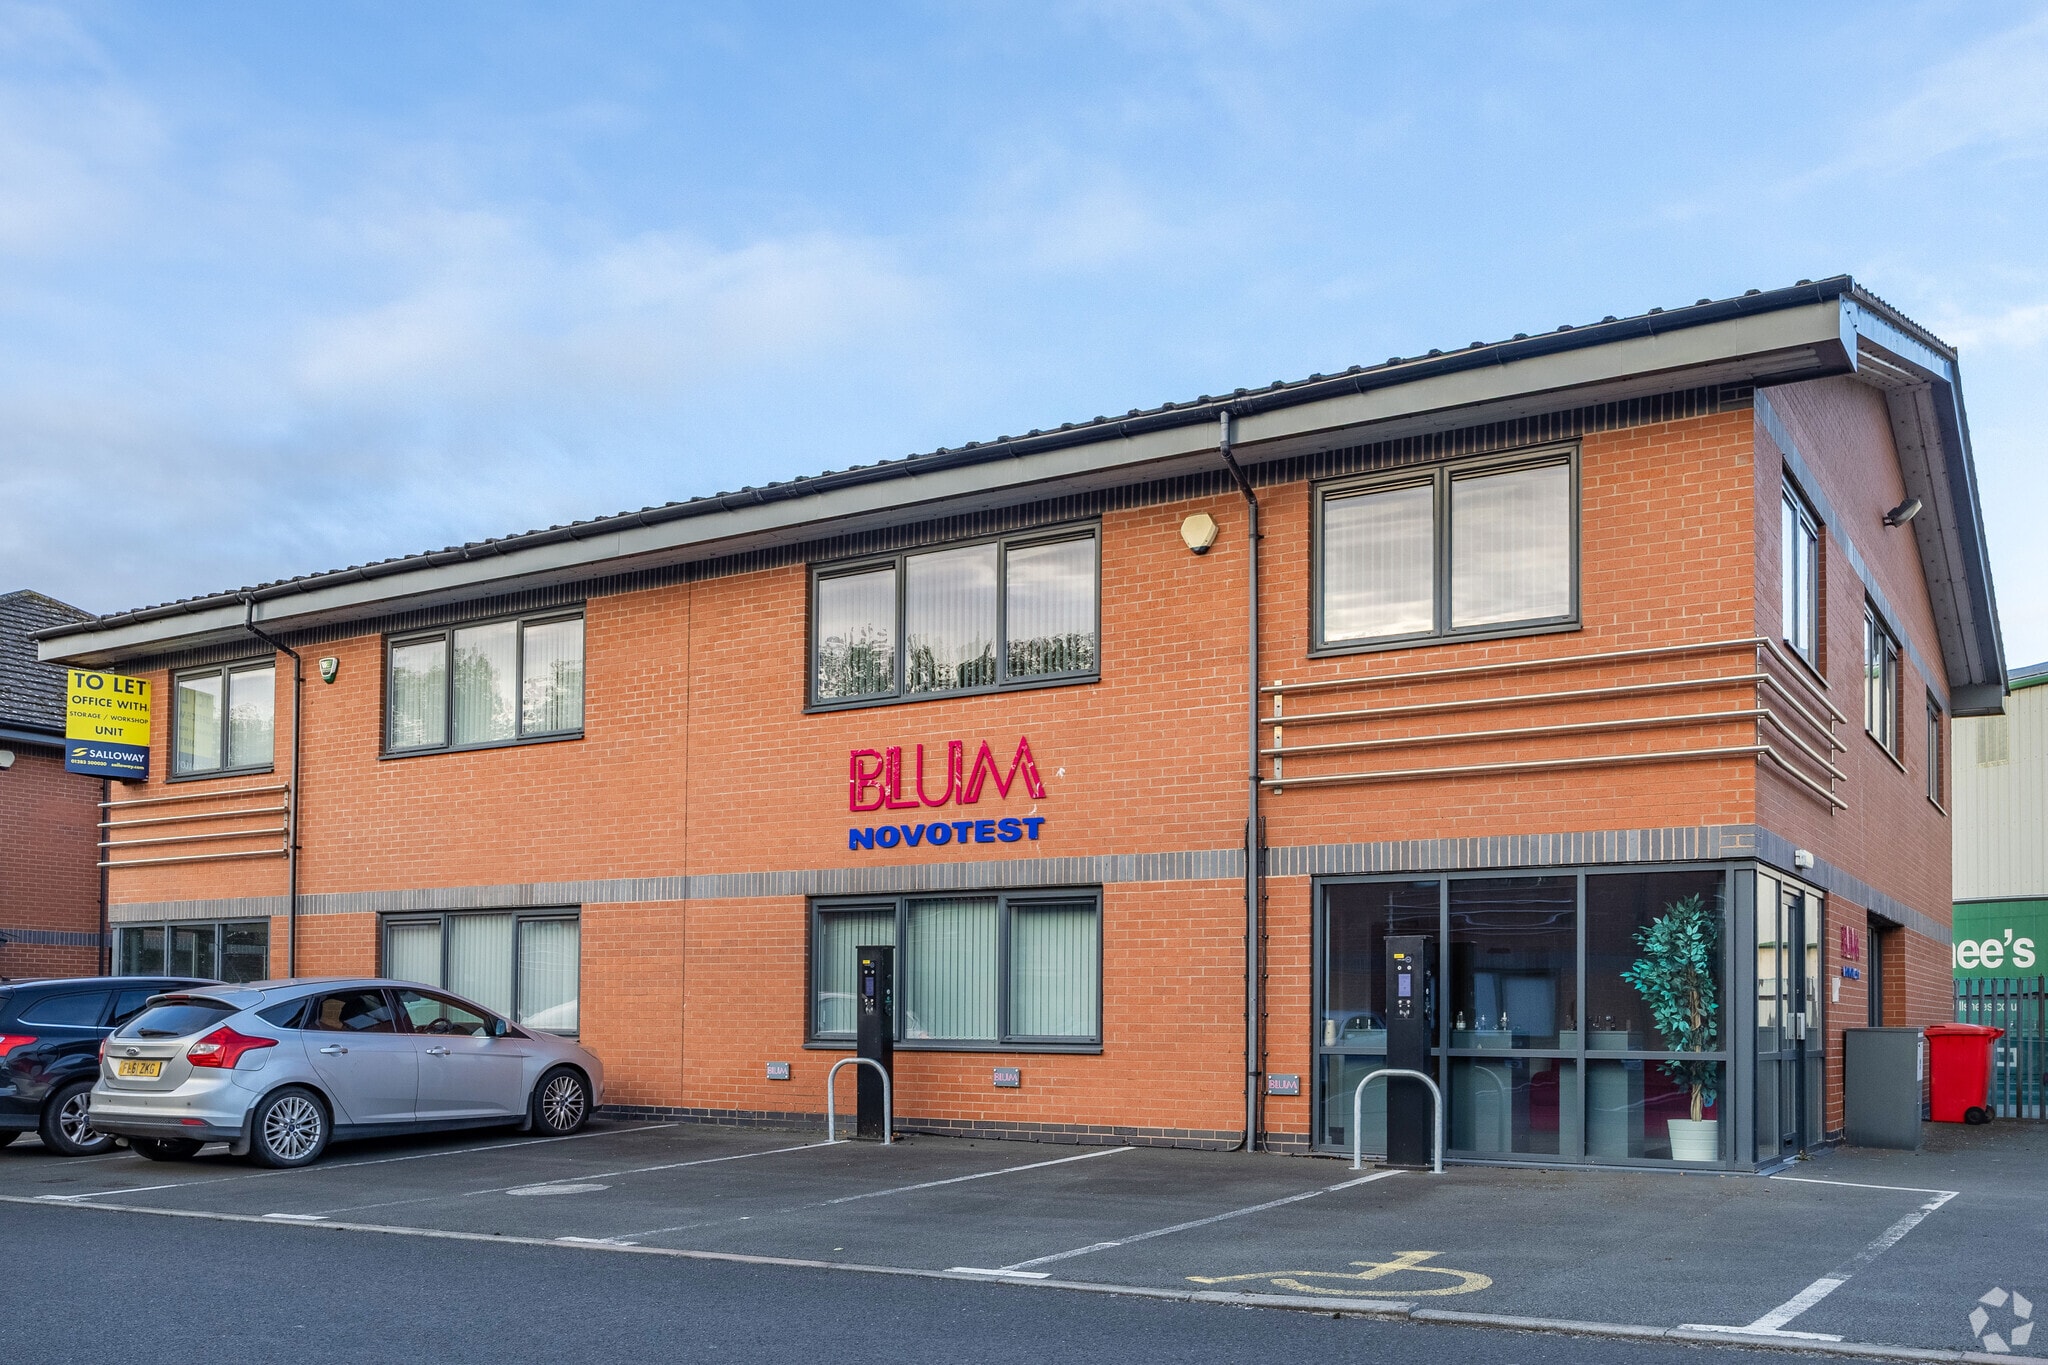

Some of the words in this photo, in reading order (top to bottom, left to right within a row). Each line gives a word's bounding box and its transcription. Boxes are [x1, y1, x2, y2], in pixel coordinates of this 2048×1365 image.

[74, 673, 104, 690] TO
[113, 677, 147, 695] LET
[71, 695, 112, 708] OFFICE
[116, 700, 147, 712] WITH
[69, 710, 101, 720] STORAGE
[110, 715, 149, 724] WORKSHOP
[95, 725, 124, 737] UNIT
[89, 749, 145, 763] SALLOWAY
[849, 735, 1047, 812] BLUM
[848, 816, 1046, 850] NOVOTEST
